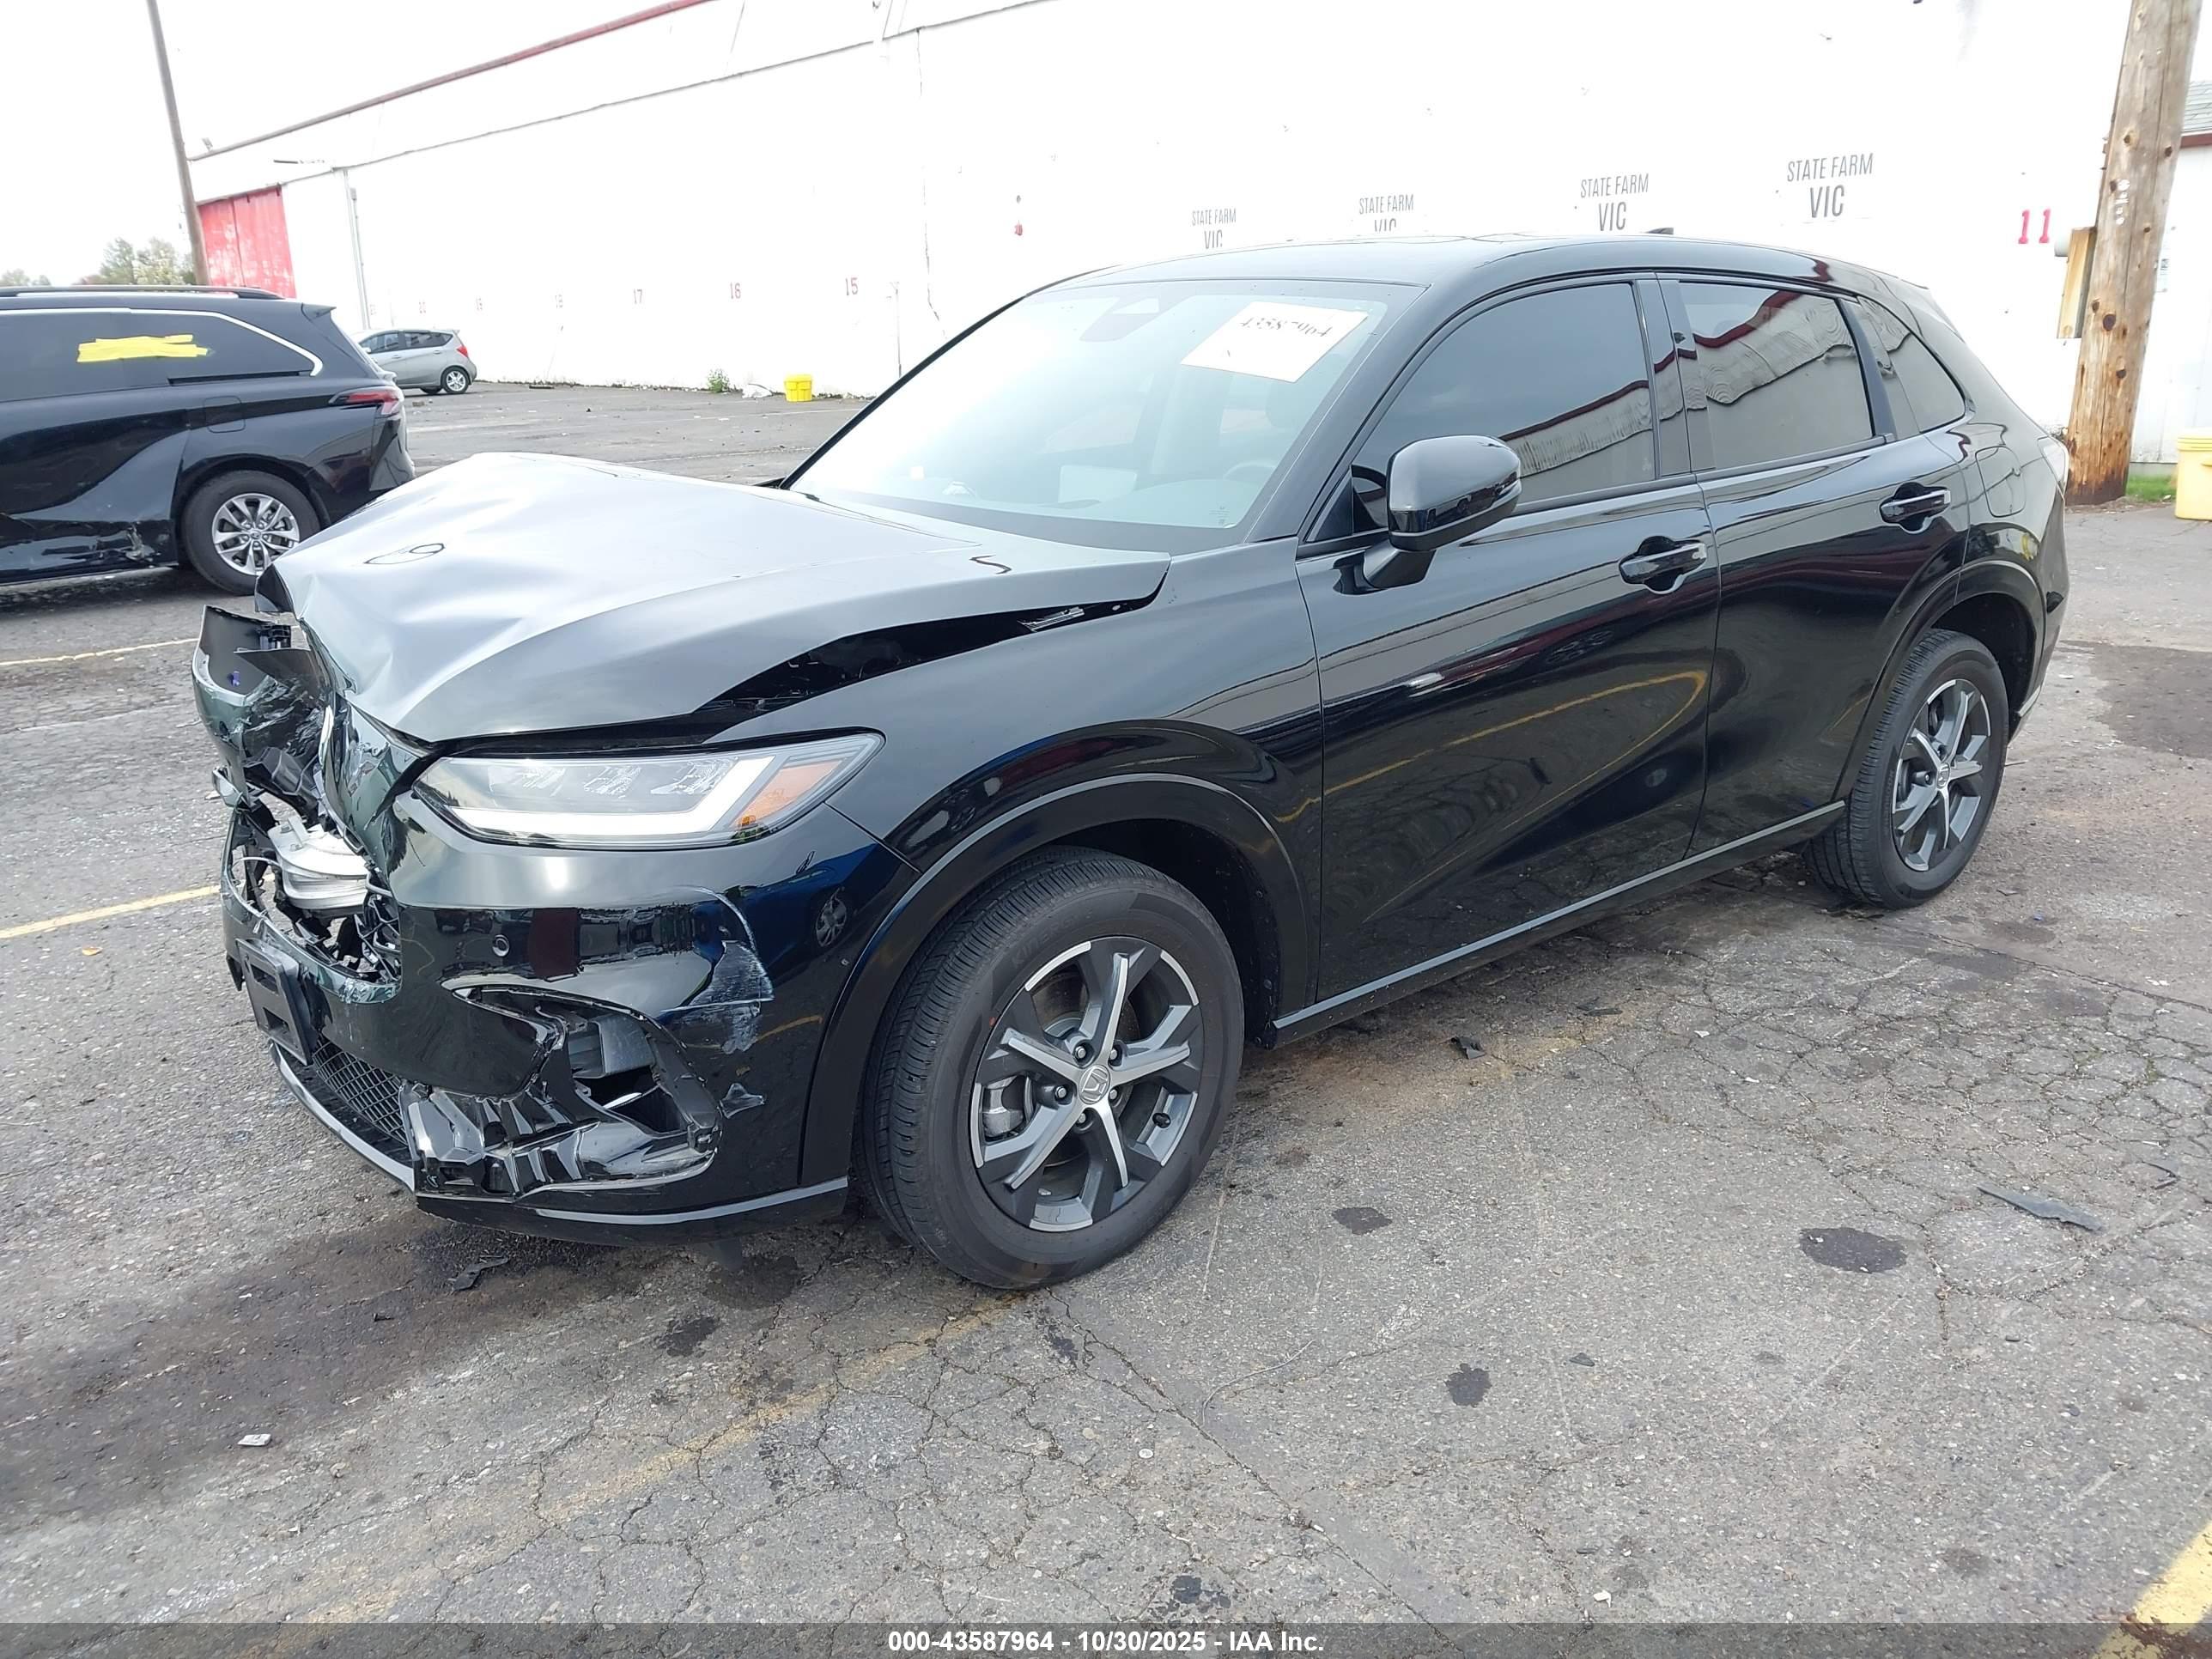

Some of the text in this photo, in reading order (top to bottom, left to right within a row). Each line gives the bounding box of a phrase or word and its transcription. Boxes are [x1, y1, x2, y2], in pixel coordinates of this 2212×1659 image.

[1787, 153, 1874, 182] STATE FARM
[1581, 173, 1649, 198] STATE FARM
[1359, 194, 1414, 215] STATE FARM
[1809, 185, 1845, 218] VIC
[1192, 208, 1237, 226] STATE FARM
[1599, 201, 1626, 231] VIC
[2018, 209, 2051, 245] 11
[1204, 229, 1223, 249] VIC
[729, 282, 742, 300] 16
[845, 276, 859, 296] 15
[633, 289, 644, 305] 17
